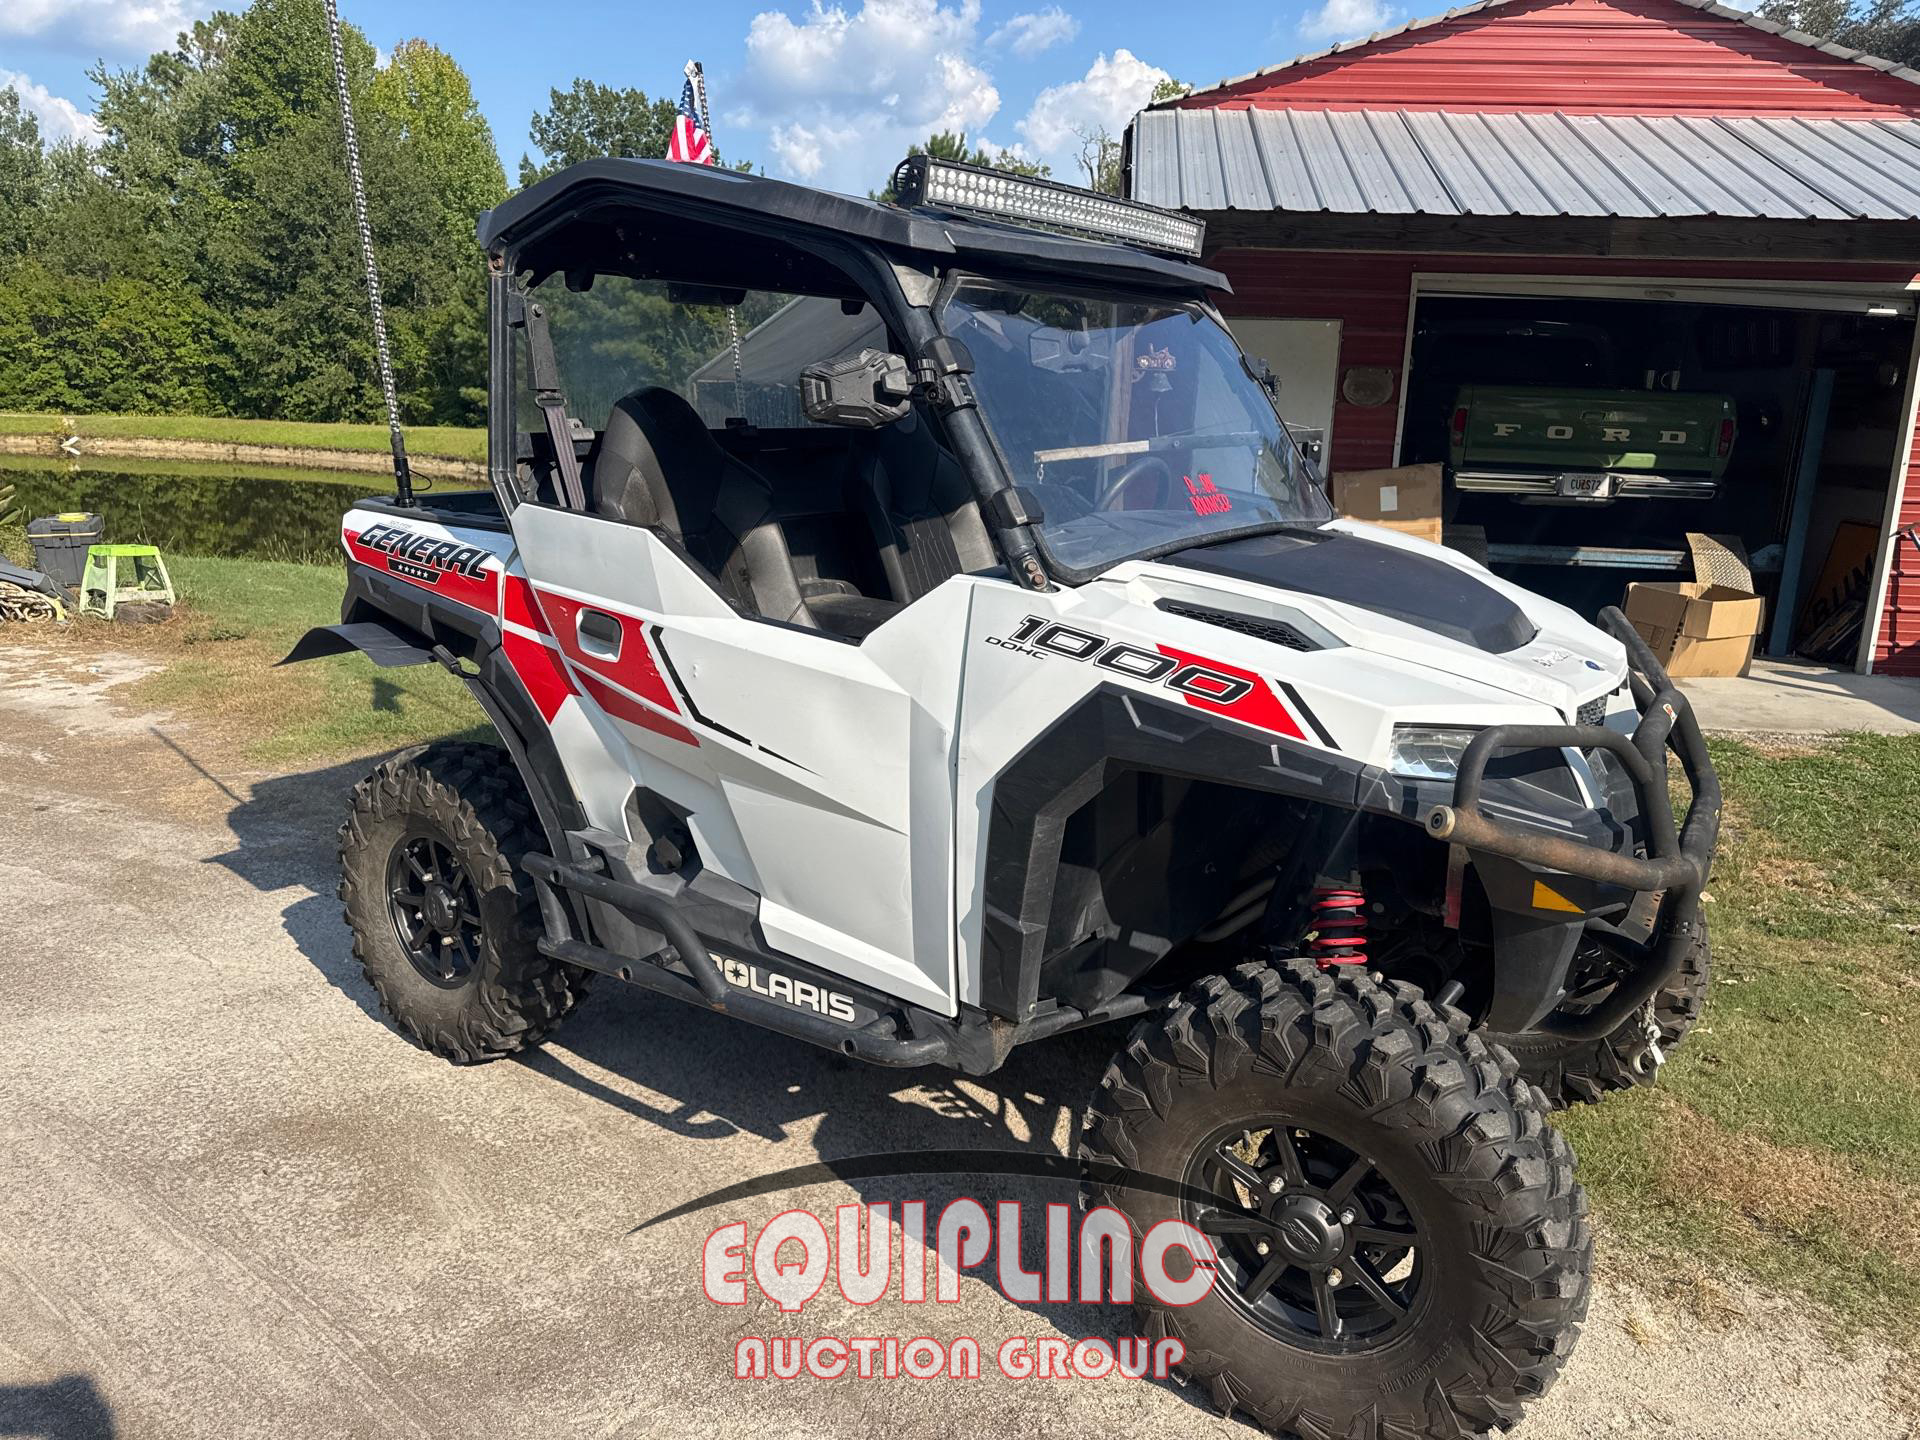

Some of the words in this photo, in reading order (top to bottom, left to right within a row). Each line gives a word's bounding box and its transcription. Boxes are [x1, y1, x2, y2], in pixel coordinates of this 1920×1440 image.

[1493, 423, 1687, 444] FORD
[356, 522, 497, 582] GENERAL
[984, 635, 1050, 661] DOHC
[1008, 613, 1255, 706] 1000
